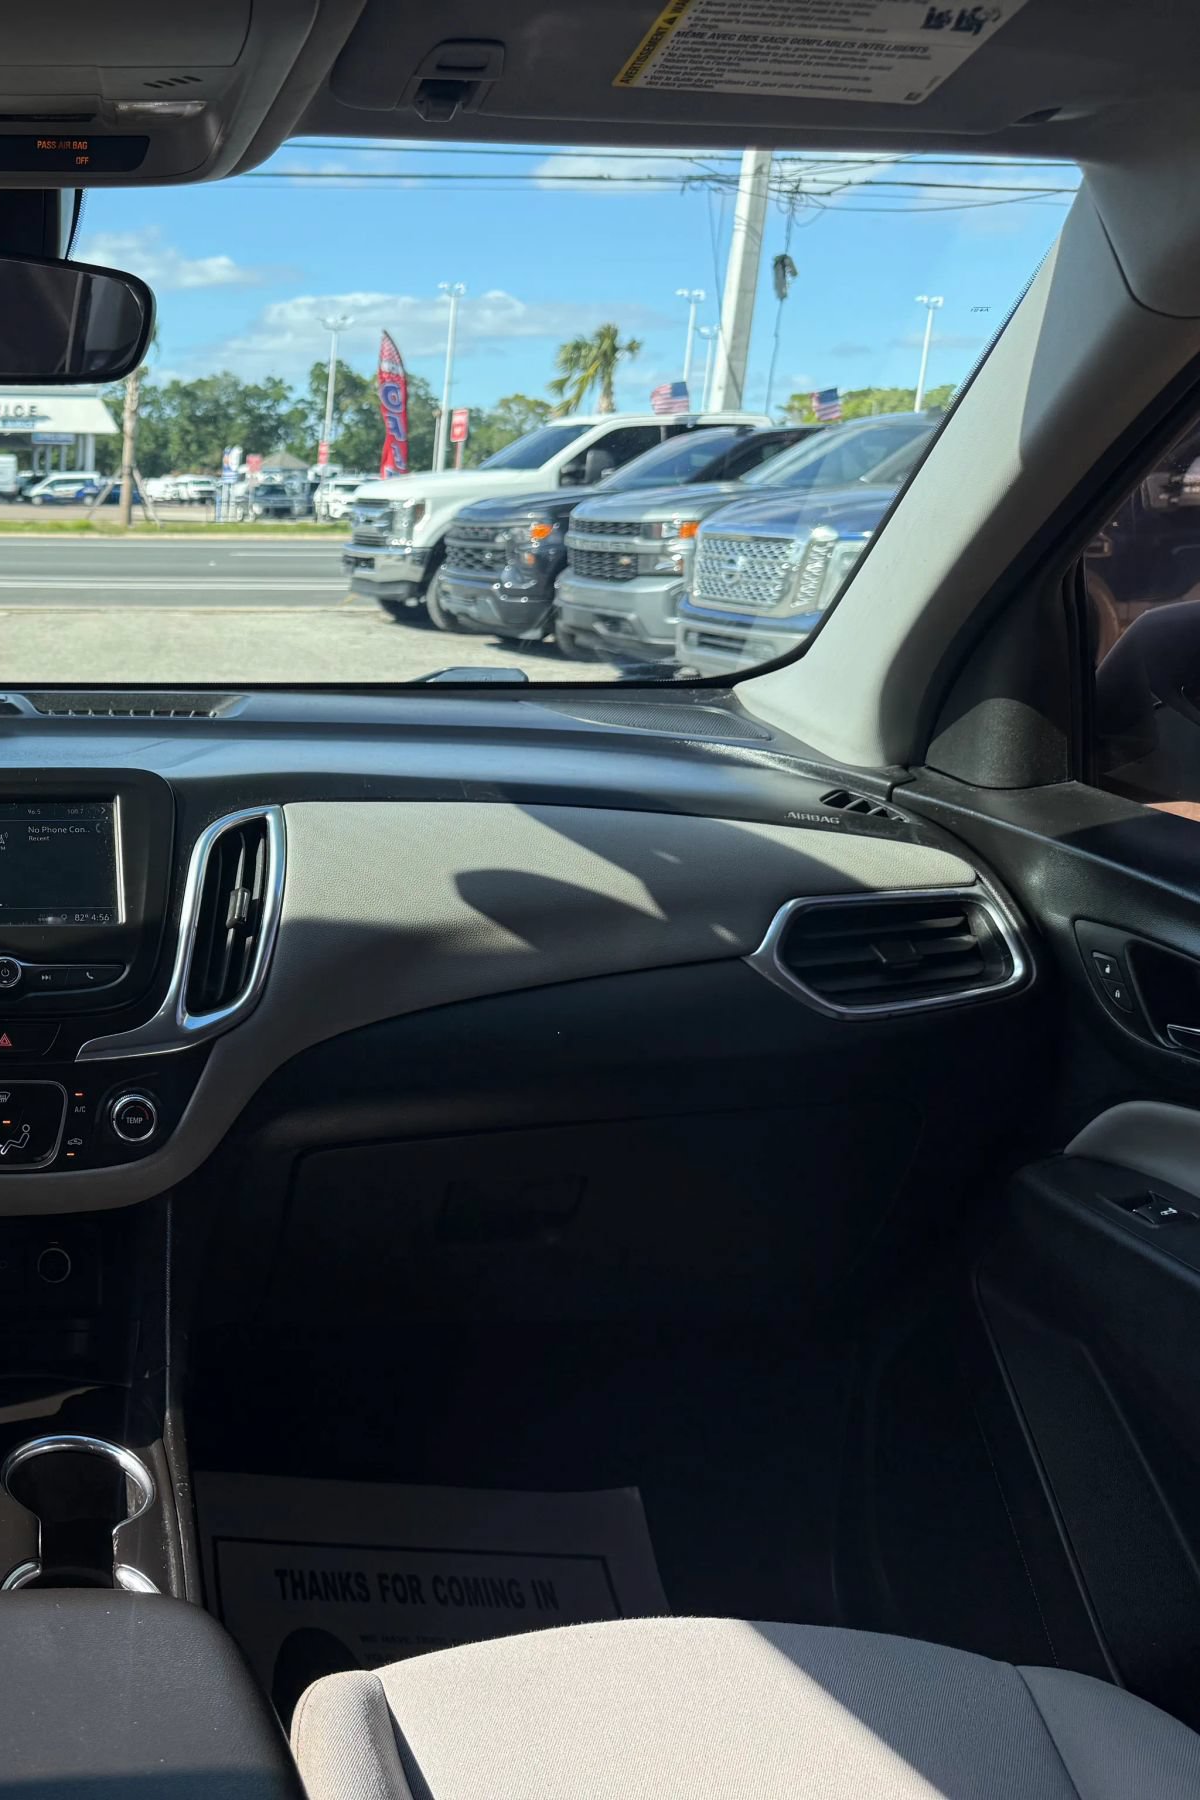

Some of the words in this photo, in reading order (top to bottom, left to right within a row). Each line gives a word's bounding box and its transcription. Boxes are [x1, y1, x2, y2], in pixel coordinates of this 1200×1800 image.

[674, 30, 706, 38] MÊME
[789, 38, 856, 48] GONFLABLES
[856, 42, 929, 53] INTELLIGENTS
[619, 27, 669, 85] AVERTISSEMENT
[36, 140, 57, 150] PASS
[58, 140, 71, 150] AIR
[72, 140, 88, 150] BAG
[75, 155, 89, 165] OFF
[787, 811, 840, 825] AIRBAG
[28, 825, 40, 834] No
[41, 825, 67, 834] Phone
[90, 913, 109, 922] 4:56
[74, 1104, 87, 1114] A/C
[125, 1115, 143, 1125] TEMP
[274, 1568, 371, 1604] THANKS
[378, 1572, 425, 1606] FOR
[433, 1575, 524, 1610] COMING
[532, 1579, 560, 1612] IN
